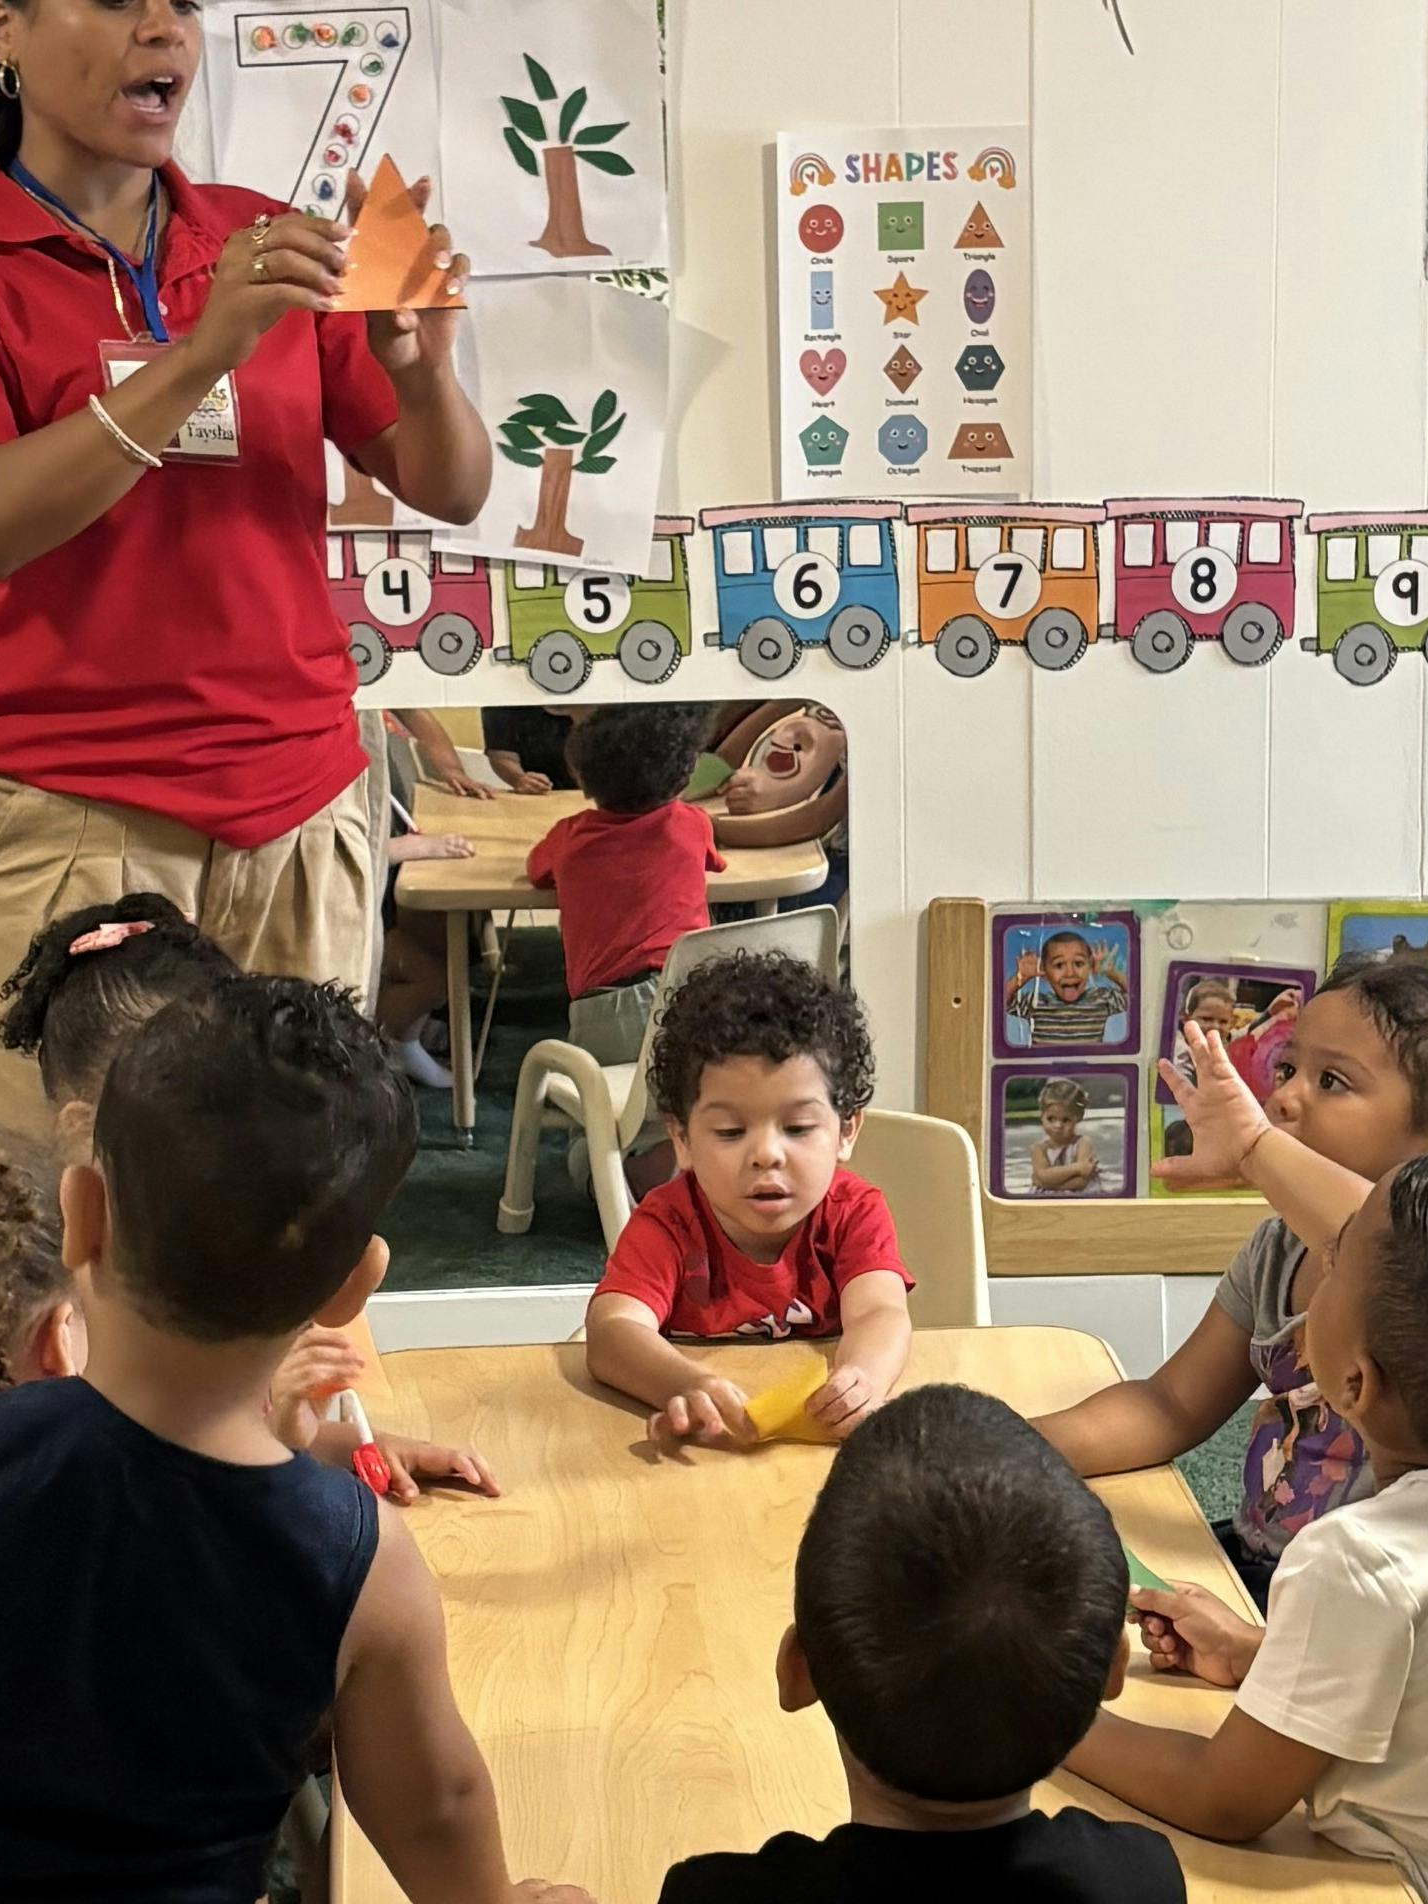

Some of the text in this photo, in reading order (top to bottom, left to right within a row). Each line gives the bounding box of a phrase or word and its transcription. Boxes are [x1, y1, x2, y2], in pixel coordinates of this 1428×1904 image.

[845, 151, 958, 184] SHAPES
[811, 257, 833, 265] Circle
[887, 255, 915, 264] Square
[964, 253, 995, 262] Triangle
[804, 333, 842, 341] Rectangle
[893, 331, 911, 339] Star
[971, 329, 989, 337] Oval
[812, 400, 835, 408] Heart
[885, 398, 919, 406] Diamond
[963, 396, 997, 405] Hexagon
[807, 468, 842, 477] Pentagon
[887, 467, 920, 476] Octagon
[962, 465, 1001, 474] Trapezoid
[993, 563, 1022, 606] 7
[1189, 558, 1216, 603] 8
[793, 563, 820, 609] 6
[381, 570, 410, 614] 4
[1392, 570, 1418, 615] 9
[583, 577, 610, 624] 5
